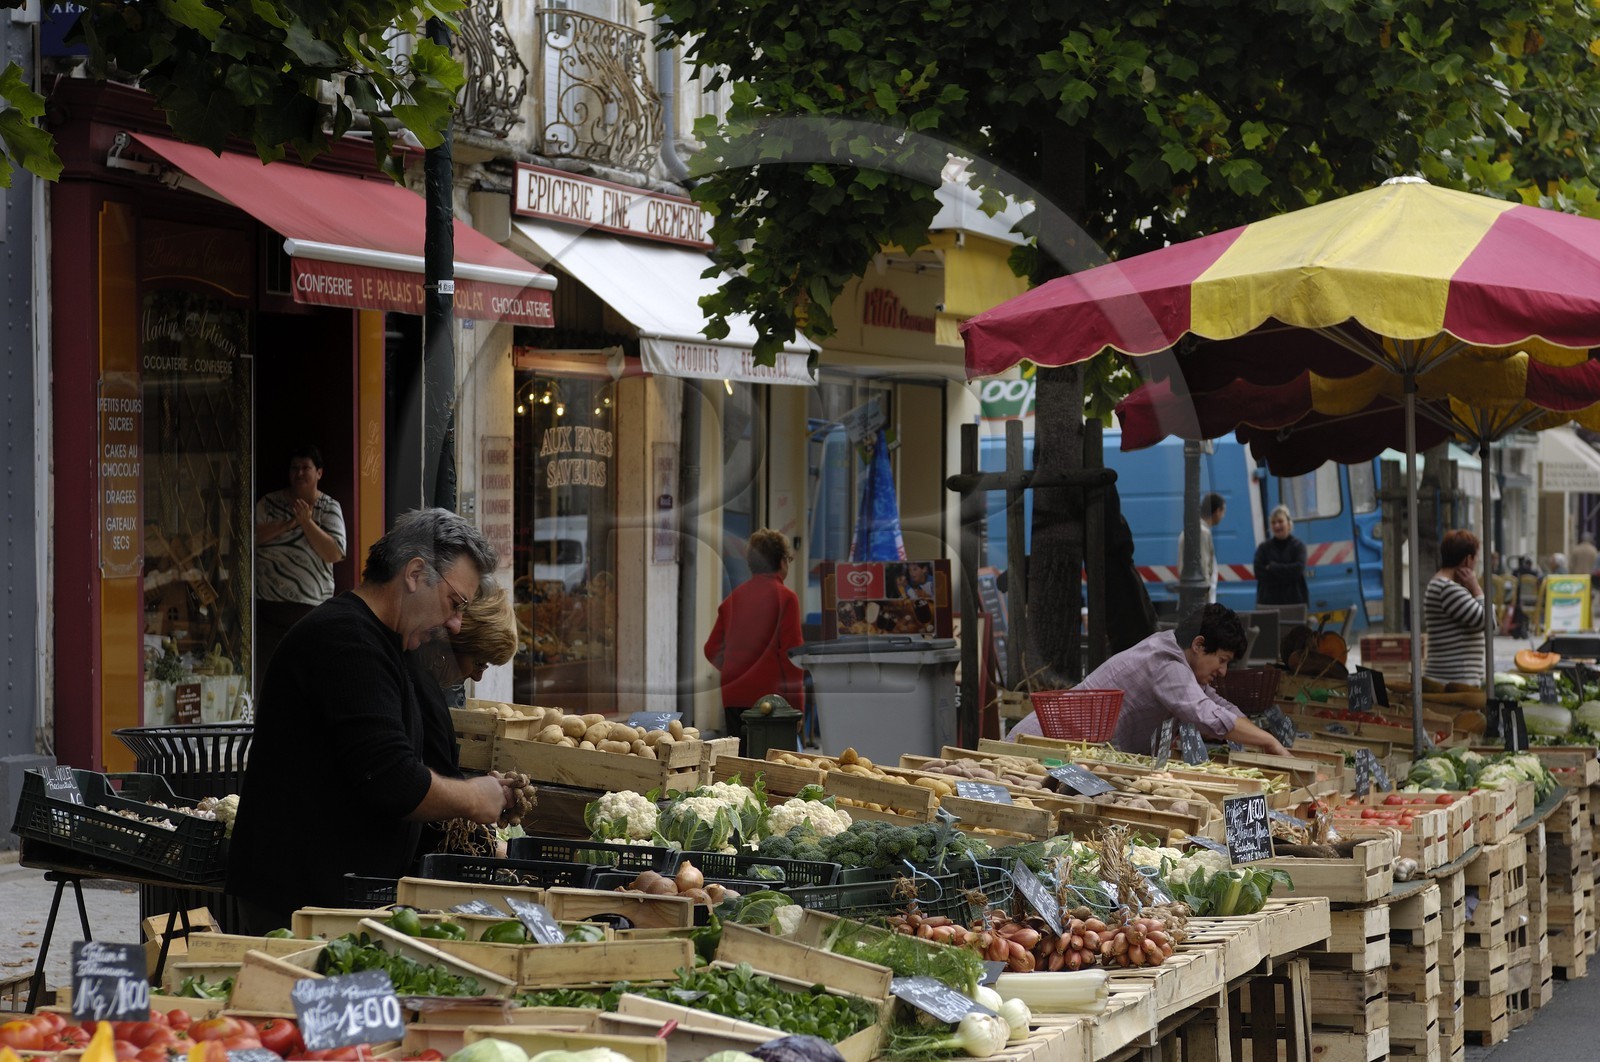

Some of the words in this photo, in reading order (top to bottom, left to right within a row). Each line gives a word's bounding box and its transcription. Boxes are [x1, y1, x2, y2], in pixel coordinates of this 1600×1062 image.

[527, 173, 593, 221] EPICERIE
[602, 190, 631, 229] FINE
[296, 272, 354, 297] CONFISERIE
[361, 277, 373, 299] LE
[377, 279, 412, 304] PALAIS
[491, 296, 551, 318] CHOCOLATERIE
[194, 359, 233, 374] CONFISERIE
[674, 345, 719, 373] PRODUITS
[100, 398, 120, 412] PETITS
[120, 399, 142, 413] FOURS
[108, 416, 134, 431] SUCRES
[540, 426, 573, 457] AUX
[574, 426, 613, 458] FINES
[104, 443, 127, 458] CAKES
[128, 444, 138, 458] AU
[101, 462, 140, 477] CHOCOLAT
[547, 459, 607, 488] SAVEURS
[105, 490, 136, 504] DRAGEES
[105, 517, 137, 531] GATEAUX
[112, 535, 130, 550] SECS
